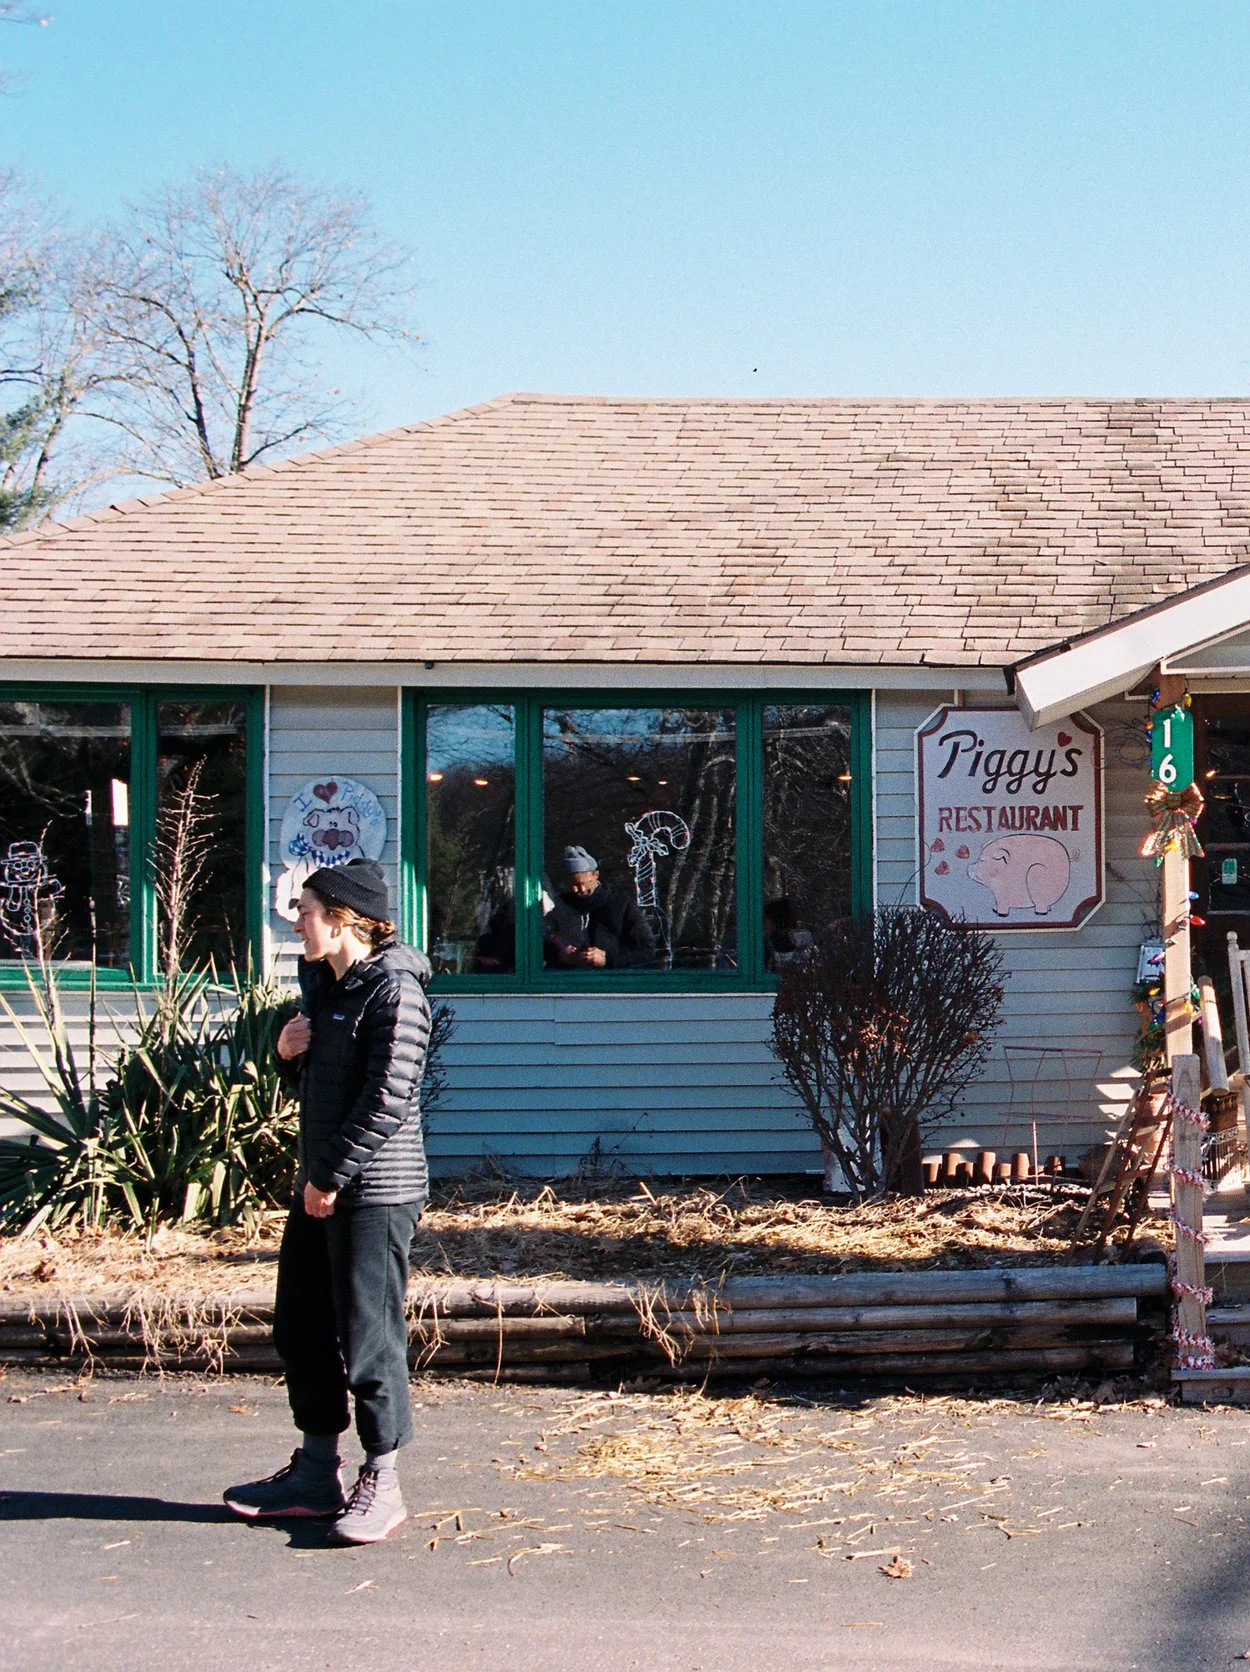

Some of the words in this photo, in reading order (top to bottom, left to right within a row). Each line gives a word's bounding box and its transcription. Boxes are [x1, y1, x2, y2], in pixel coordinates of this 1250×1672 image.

[936, 729, 1083, 795] Piggy's
[292, 792, 313, 813] I
[937, 804, 1084, 833] RESTAURANT
